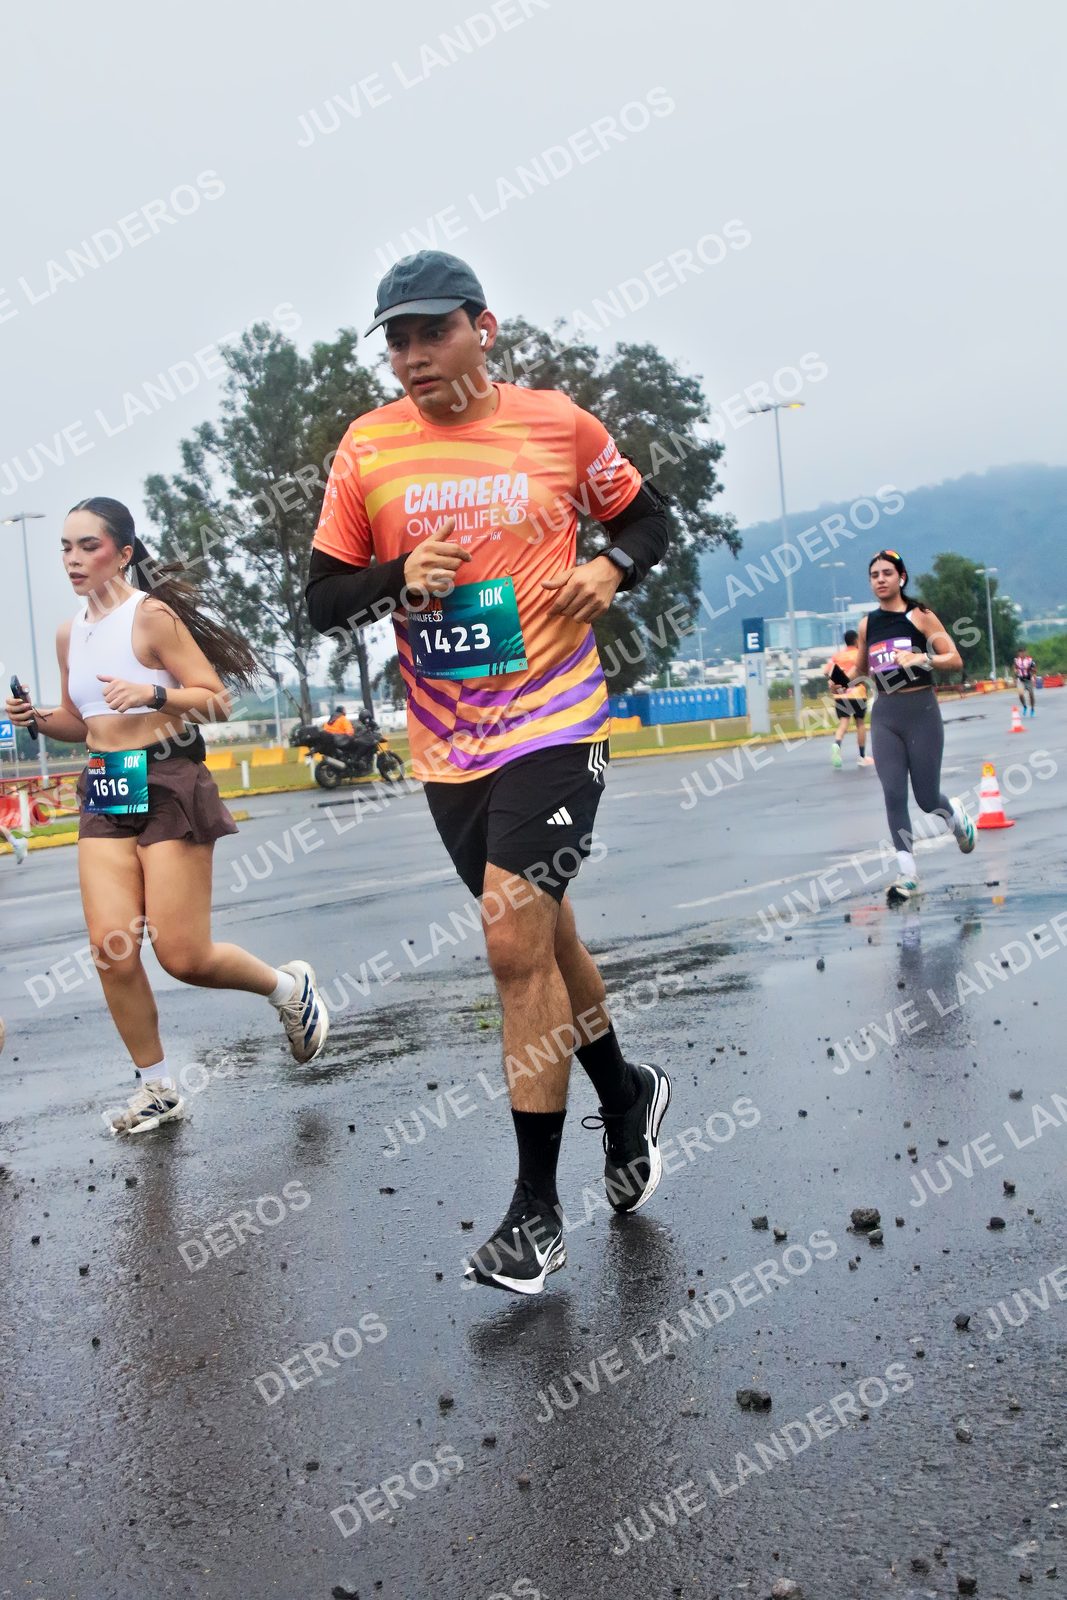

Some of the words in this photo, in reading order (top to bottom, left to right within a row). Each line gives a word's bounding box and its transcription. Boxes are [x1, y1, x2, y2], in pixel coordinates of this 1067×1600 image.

[404, 473, 529, 514] CARRERA
[460, 535, 472, 545] 10K
[479, 586, 503, 608] 10K
[420, 623, 491, 654] 1423
[747, 632, 760, 649] E
[124, 756, 140, 768] 10K
[93, 778, 129, 796] 1616
